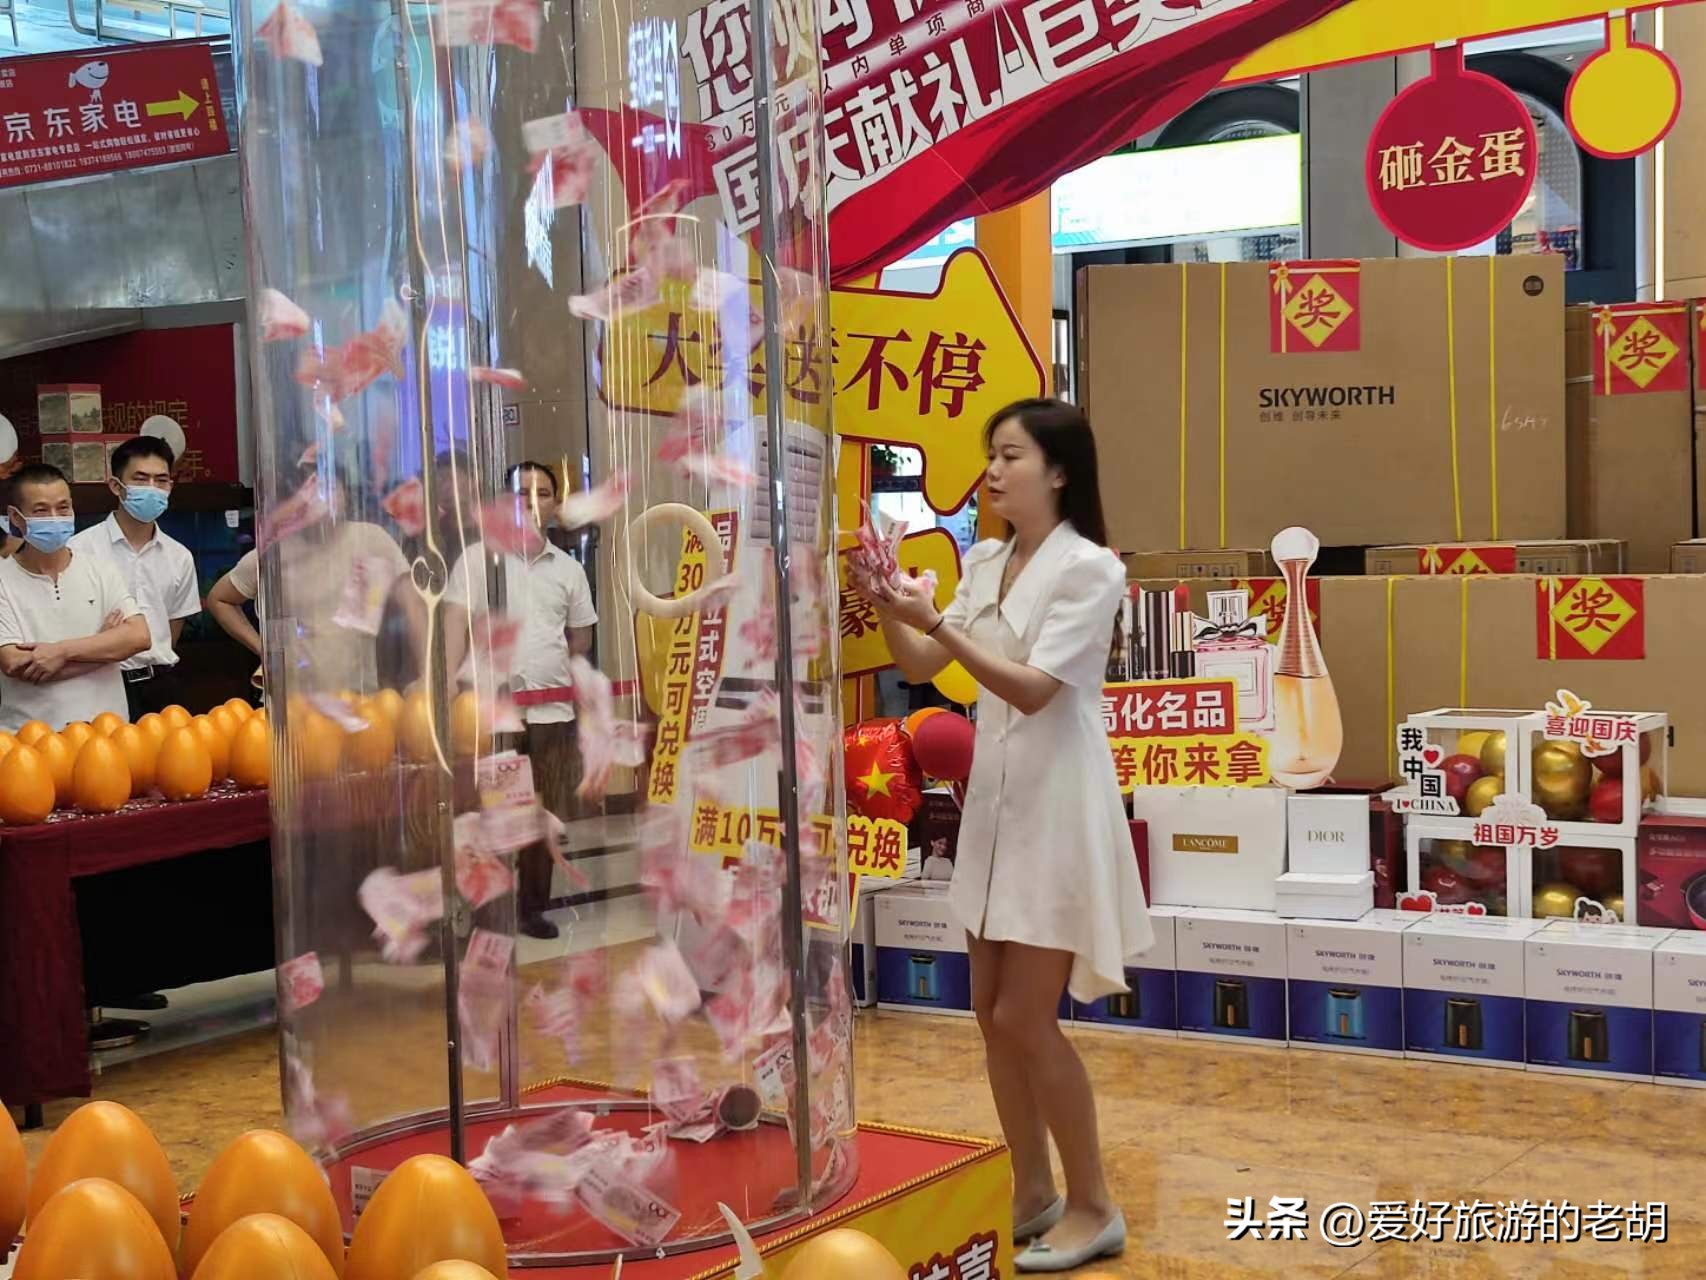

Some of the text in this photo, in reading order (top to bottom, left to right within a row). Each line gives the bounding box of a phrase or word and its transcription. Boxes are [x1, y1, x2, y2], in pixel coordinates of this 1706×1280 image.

[3, 100, 142, 144] 京东家电
[1378, 126, 1527, 191] 砸金蛋
[1299, 288, 1341, 329] 奖
[1618, 330, 1667, 370] 奖
[1259, 386, 1395, 408] SKYWORTH
[1564, 587, 1621, 633] 奖
[1401, 728, 1423, 751] 我
[1545, 714, 1637, 742] 喜迎国庆
[1112, 740, 1263, 786] 等你来拿
[1411, 799, 1455, 812] CHINA
[1307, 830, 1345, 843] DIOR
[1473, 823, 1560, 846] 祖国万岁
[1202, 942, 1242, 951] SKYWORTH
[1315, 950, 1356, 960] SKYWORTH
[1433, 958, 1476, 969] SKYWORTH
[1556, 968, 1601, 979] SKYWORTH
